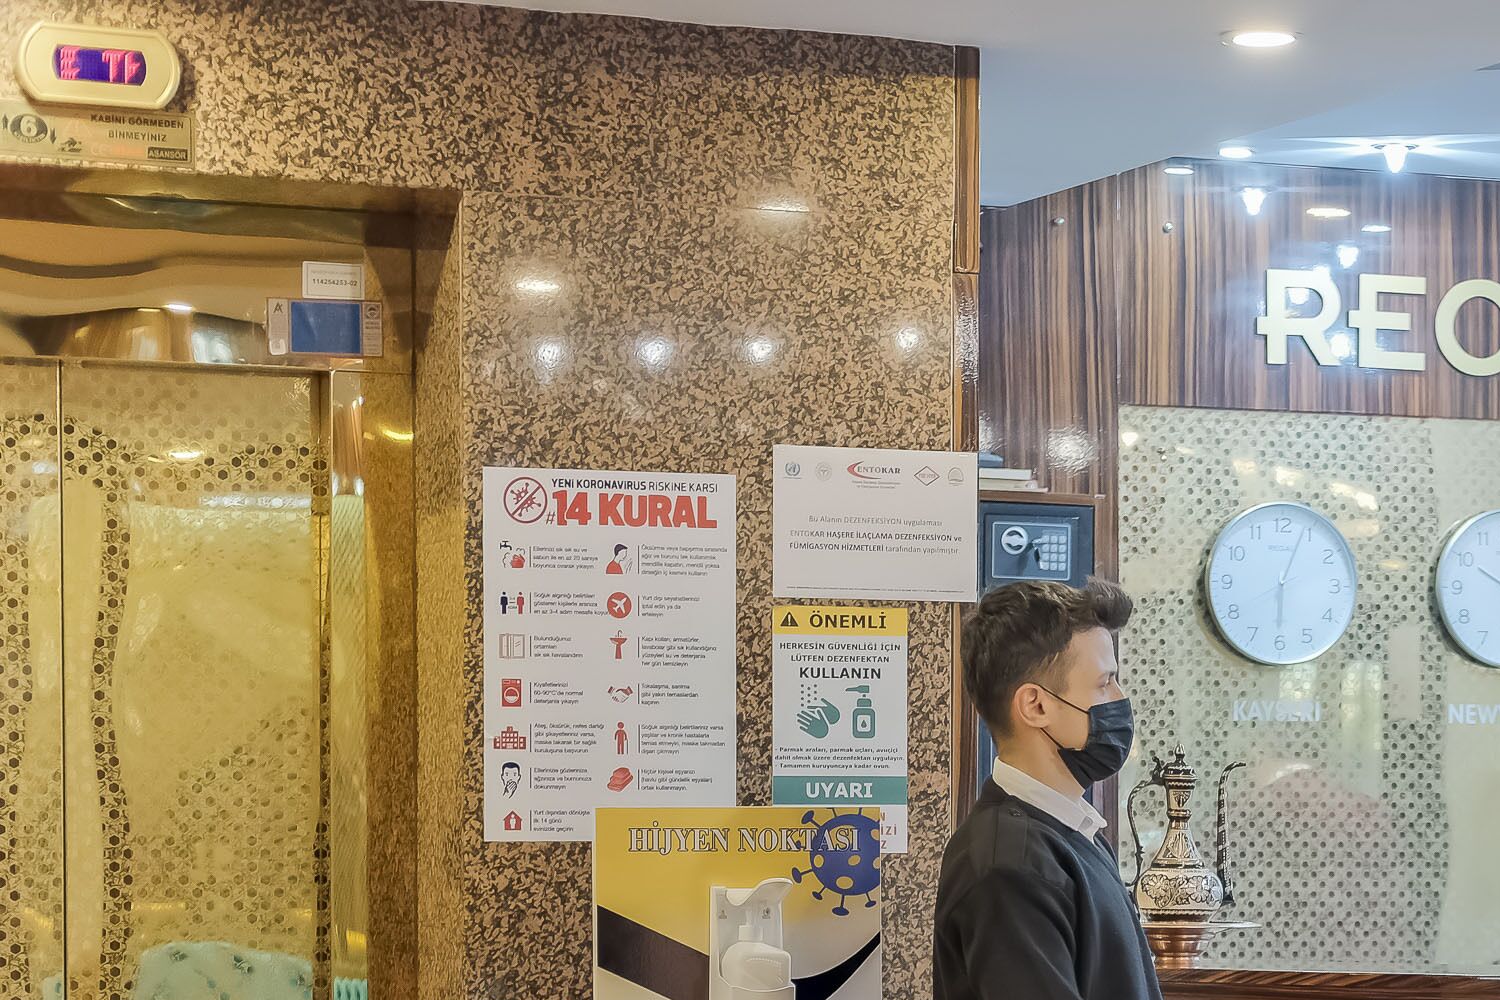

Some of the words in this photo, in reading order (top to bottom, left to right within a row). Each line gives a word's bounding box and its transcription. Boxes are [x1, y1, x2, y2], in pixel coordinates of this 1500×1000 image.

[857, 466, 901, 474] ENTOKAR
[599, 493, 717, 528] KURAL
[1250, 526, 1262, 540] 11
[1273, 518, 1292, 533] 12
[895, 532, 952, 542] DEZENFEKSİYON
[1306, 528, 1312, 542] 1
[1478, 532, 1489, 546] 11
[789, 541, 840, 551] FÜMİGASYON
[841, 542, 884, 552] HİZMETLERİ
[1229, 545, 1245, 561] 10
[1322, 549, 1334, 564] 2
[1458, 552, 1474, 567] 10
[1221, 574, 1232, 590] 9
[1329, 579, 1341, 594] 3
[1451, 580, 1463, 595] 9
[1228, 604, 1240, 619] 8
[1321, 608, 1333, 622] 4
[1459, 609, 1470, 624] 8
[810, 610, 886, 629] ÖNEMLİ
[1247, 627, 1258, 642] 7
[1301, 628, 1313, 644] 5
[1477, 631, 1488, 645] 7
[780, 641, 825, 650] HERKESİN
[828, 642, 877, 650] GÜVENLİĞİ
[881, 643, 900, 652] İÇİN
[1274, 635, 1286, 651] 6
[791, 654, 824, 662] LÜTFEN
[827, 655, 889, 663] DEZENFEKTAN
[800, 667, 881, 679] KULLANIN
[1232, 696, 1321, 721] KAYSERİ
[806, 782, 873, 798] UYARI
[628, 821, 730, 855] HİJYEN
[738, 827, 862, 853] NOKTASI
